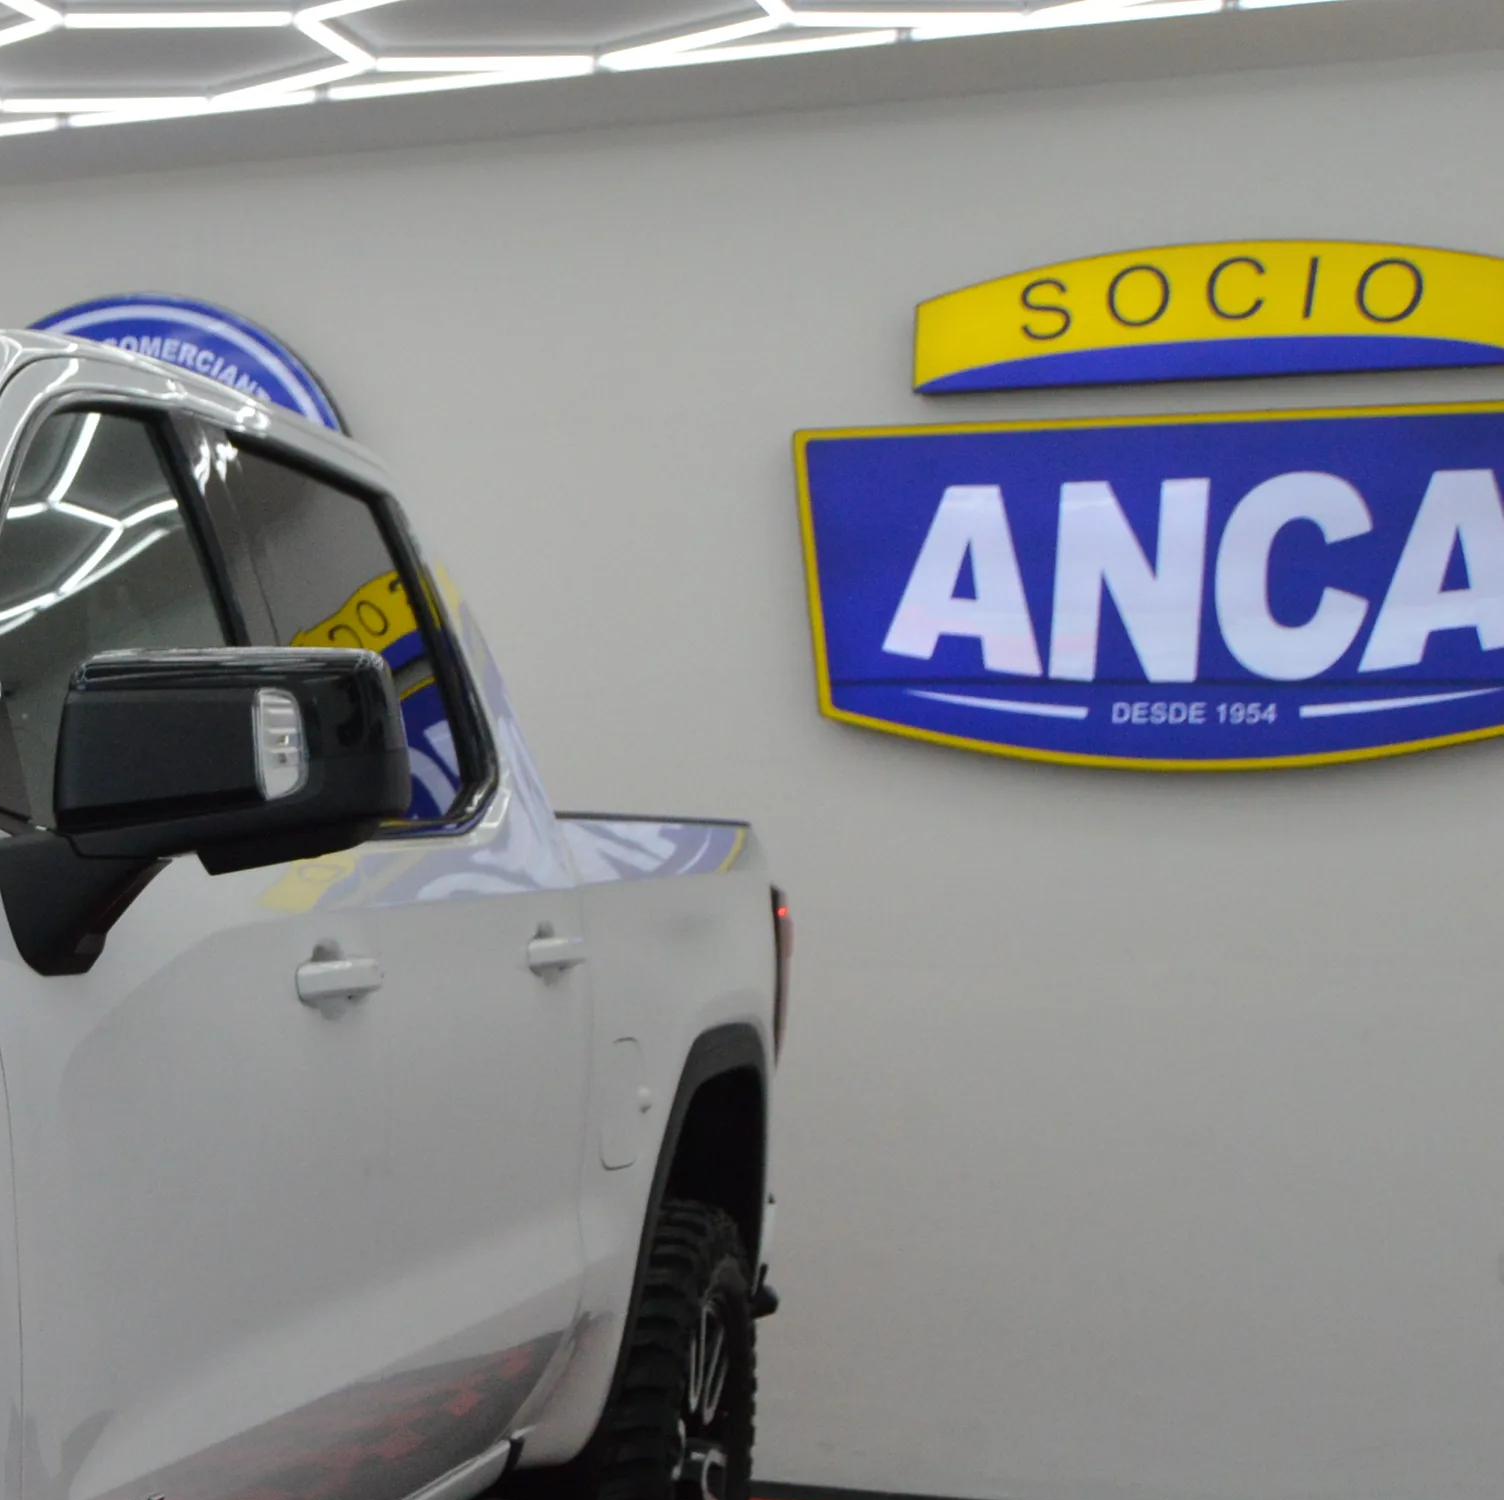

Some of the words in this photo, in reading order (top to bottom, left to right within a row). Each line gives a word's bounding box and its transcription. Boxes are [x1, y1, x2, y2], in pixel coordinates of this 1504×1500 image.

[1020, 256, 1424, 341] SOCIO
[881, 469, 1504, 683] ANCA
[1111, 702, 1206, 725] DESDE
[1216, 702, 1279, 725] 1954
